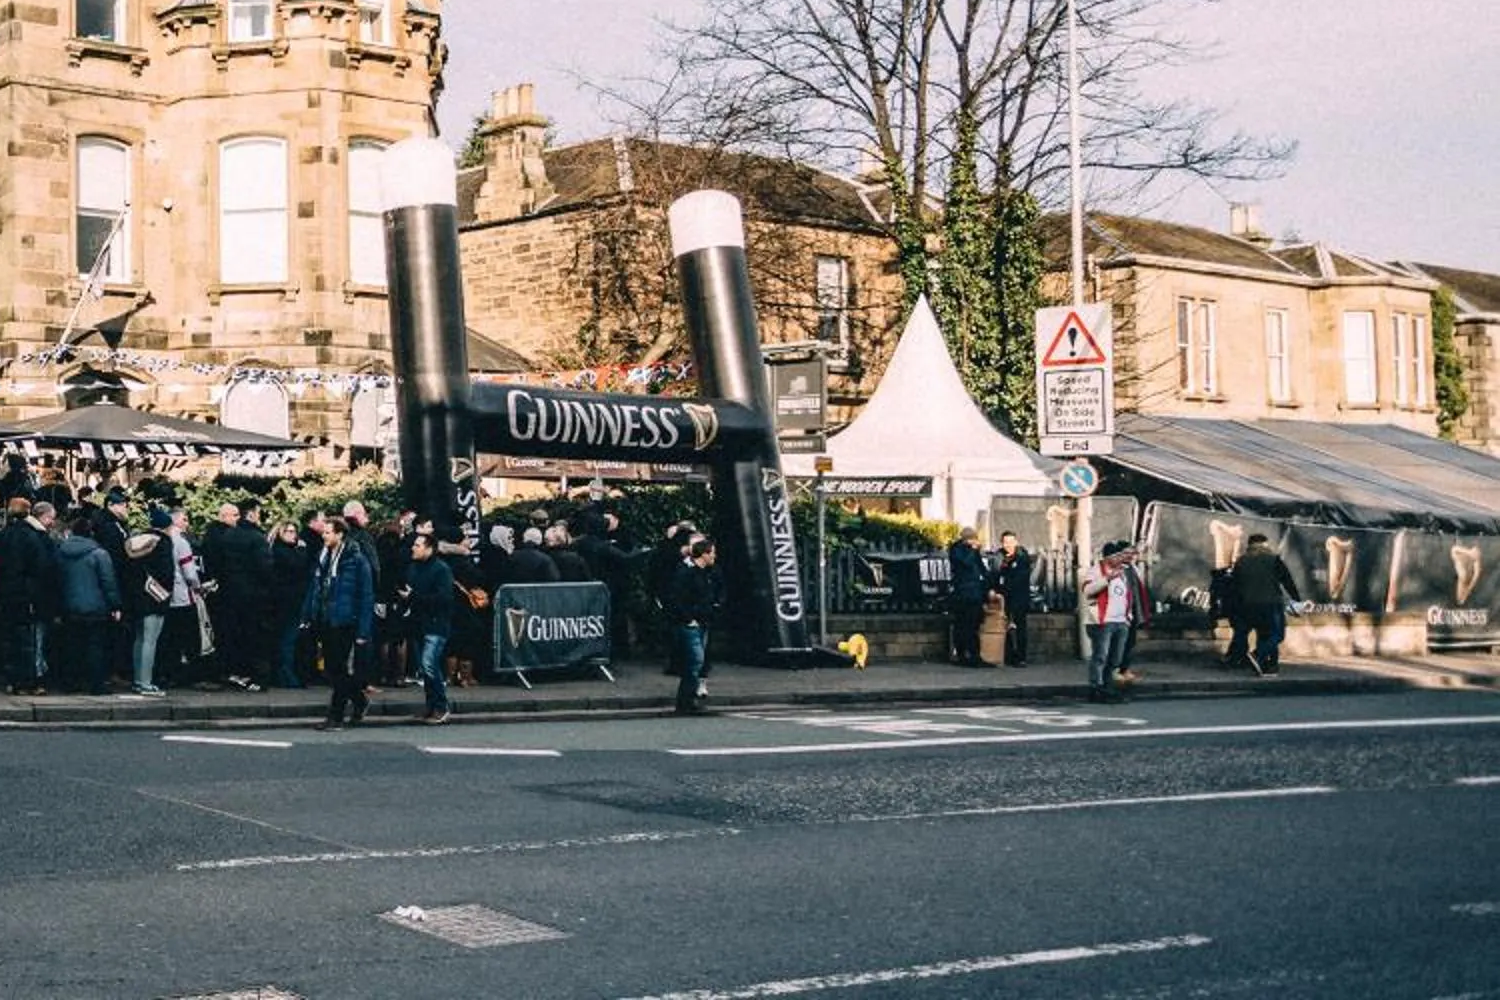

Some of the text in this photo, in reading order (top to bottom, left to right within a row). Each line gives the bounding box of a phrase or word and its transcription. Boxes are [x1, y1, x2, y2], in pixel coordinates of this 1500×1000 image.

[507, 390, 680, 449] GUINNESS
[1063, 439, 1090, 451] End
[769, 499, 803, 622] GUINNESS
[527, 614, 605, 642] GUINNESS
